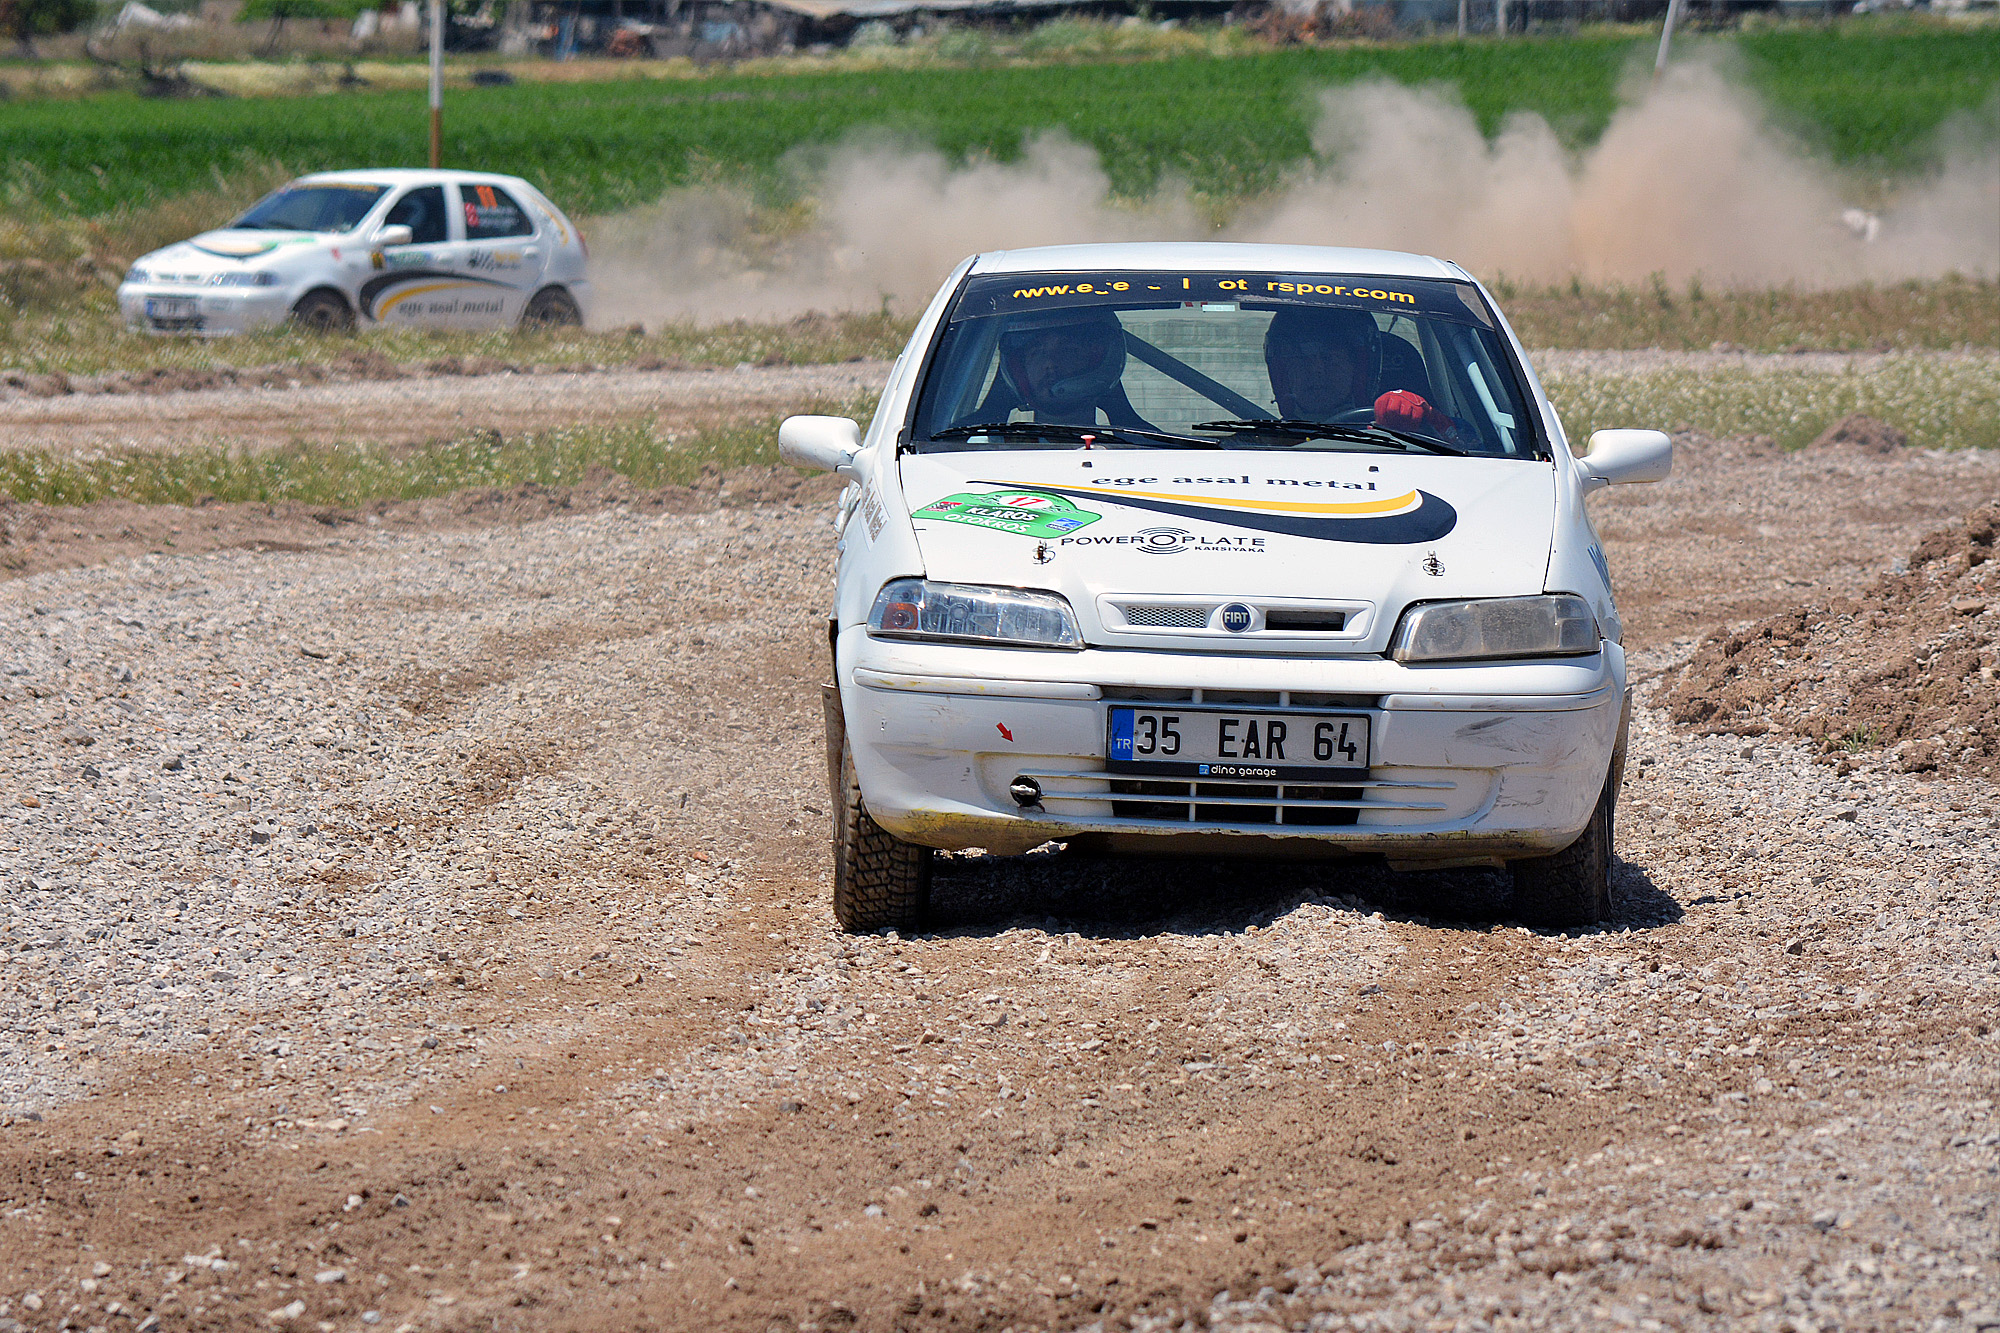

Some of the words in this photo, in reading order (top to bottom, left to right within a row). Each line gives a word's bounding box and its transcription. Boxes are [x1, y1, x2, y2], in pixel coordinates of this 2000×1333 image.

[1091, 477, 1158, 486] ege
[1172, 475, 1250, 484] asal
[1266, 478, 1378, 491] metal
[1008, 496, 1046, 507] 17
[965, 507, 1040, 521] KLAROS
[943, 513, 1032, 533] OTOKROS
[1061, 535, 1145, 546] POWER
[1181, 536, 1266, 547] PLATE
[1224, 611, 1248, 624] FIAT
[1116, 738, 1132, 750] TR
[1136, 715, 1181, 756] 35
[1217, 718, 1288, 760] EAR
[1313, 722, 1358, 762] 64
[1210, 765, 1236, 775] dino
[1238, 767, 1277, 778] garage
